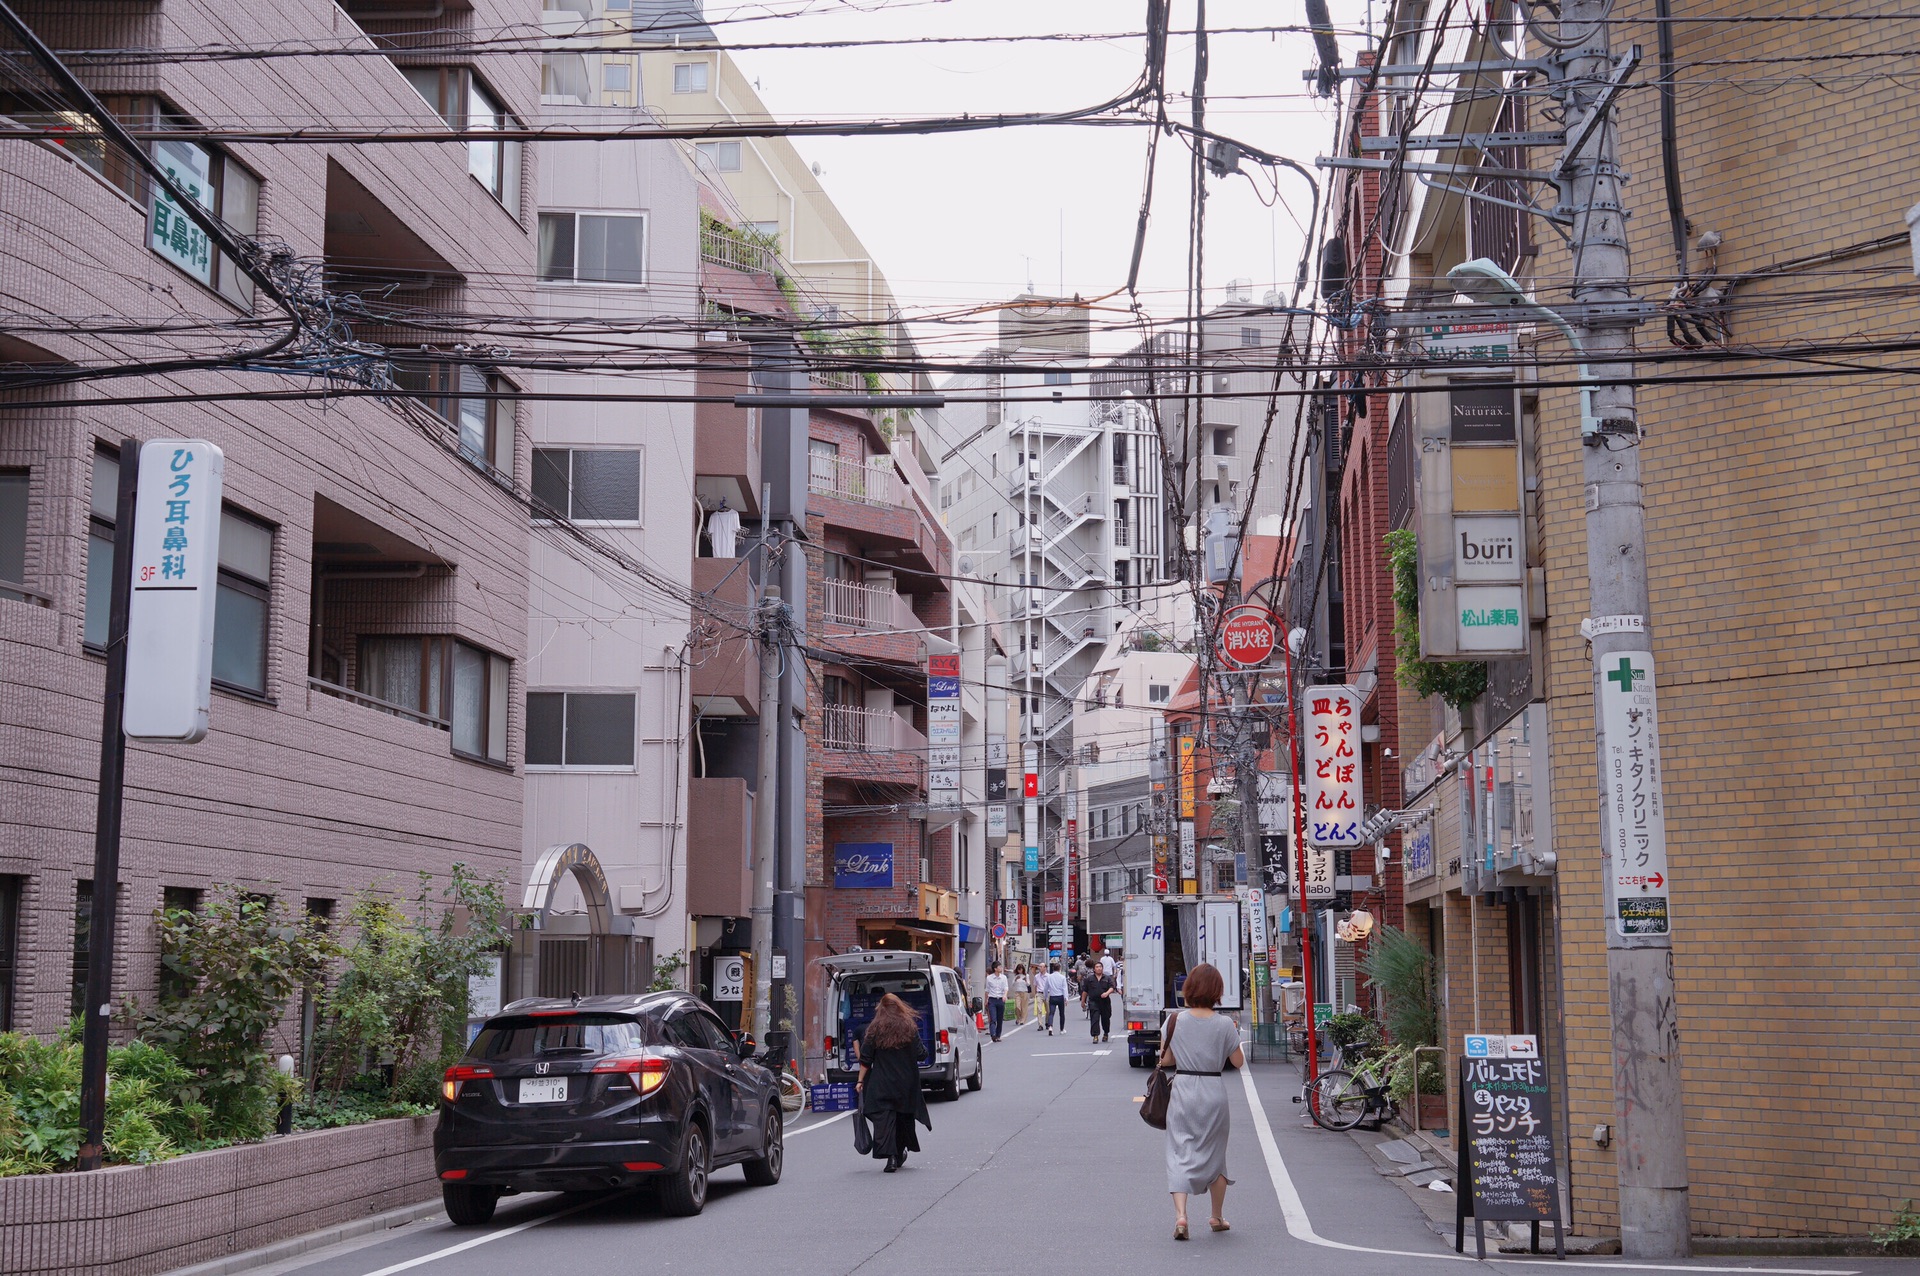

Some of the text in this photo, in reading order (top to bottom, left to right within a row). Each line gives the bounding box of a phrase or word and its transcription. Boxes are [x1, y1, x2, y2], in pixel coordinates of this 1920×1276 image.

[153, 202, 208, 273] 耳鼻科
[1453, 404, 1504, 417] Naturax
[1422, 436, 1447, 453] 2F
[160, 447, 194, 582] ひろ耳鼻科
[1460, 531, 1513, 560] buri
[140, 565, 156, 582] 3F
[1427, 575, 1452, 592] 1F
[1461, 608, 1519, 628] 松山薬局
[1227, 628, 1270, 650] 消火栓
[1630, 669, 1645, 680] Sun
[1632, 682, 1653, 693] Kitano
[930, 704, 958, 713] なかよし
[1633, 694, 1652, 705] Clinic
[1311, 697, 1334, 811] 皿うどん
[1334, 695, 1356, 811] ちゃんぽん
[1612, 746, 1624, 754] Tel.
[1615, 758, 1623, 778] 03
[1615, 783, 1625, 823] 3461
[1313, 821, 1358, 841] どんく
[1263, 839, 1283, 873] えびす
[1618, 828, 1628, 868] 3317
[845, 854, 889, 874] Link
[1291, 885, 1331, 894] KllaBo
[1618, 875, 1647, 886] ここ右折
[1466, 1059, 1542, 1085] バルコモド
[1472, 1112, 1541, 1136] ランチ
